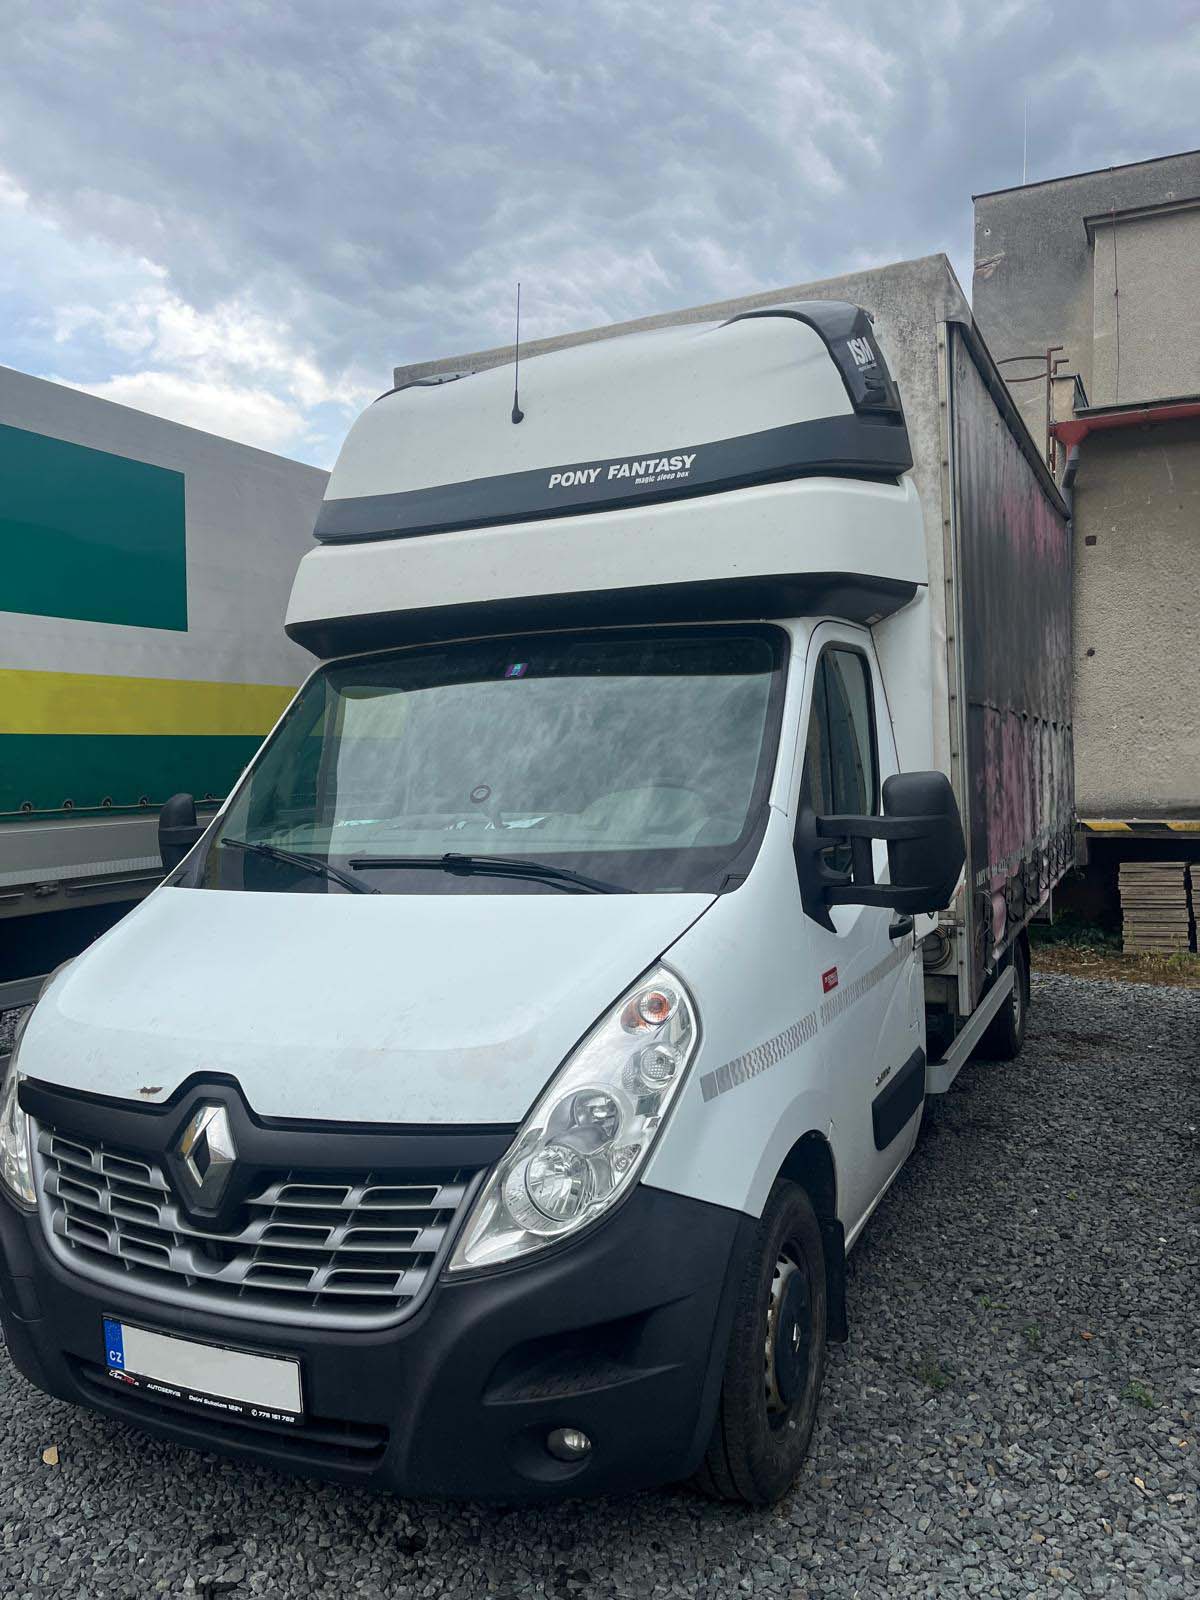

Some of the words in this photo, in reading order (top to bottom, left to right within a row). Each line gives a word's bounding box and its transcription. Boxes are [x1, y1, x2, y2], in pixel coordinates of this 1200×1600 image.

[847, 336, 875, 366] ISM
[548, 467, 602, 489] PONY
[607, 453, 697, 480] FANTASY
[635, 474, 656, 485] magic
[657, 472, 676, 482] sleep
[676, 470, 690, 479] box
[109, 1350, 123, 1363] CZ
[146, 1383, 181, 1397] AUTOSERVIS
